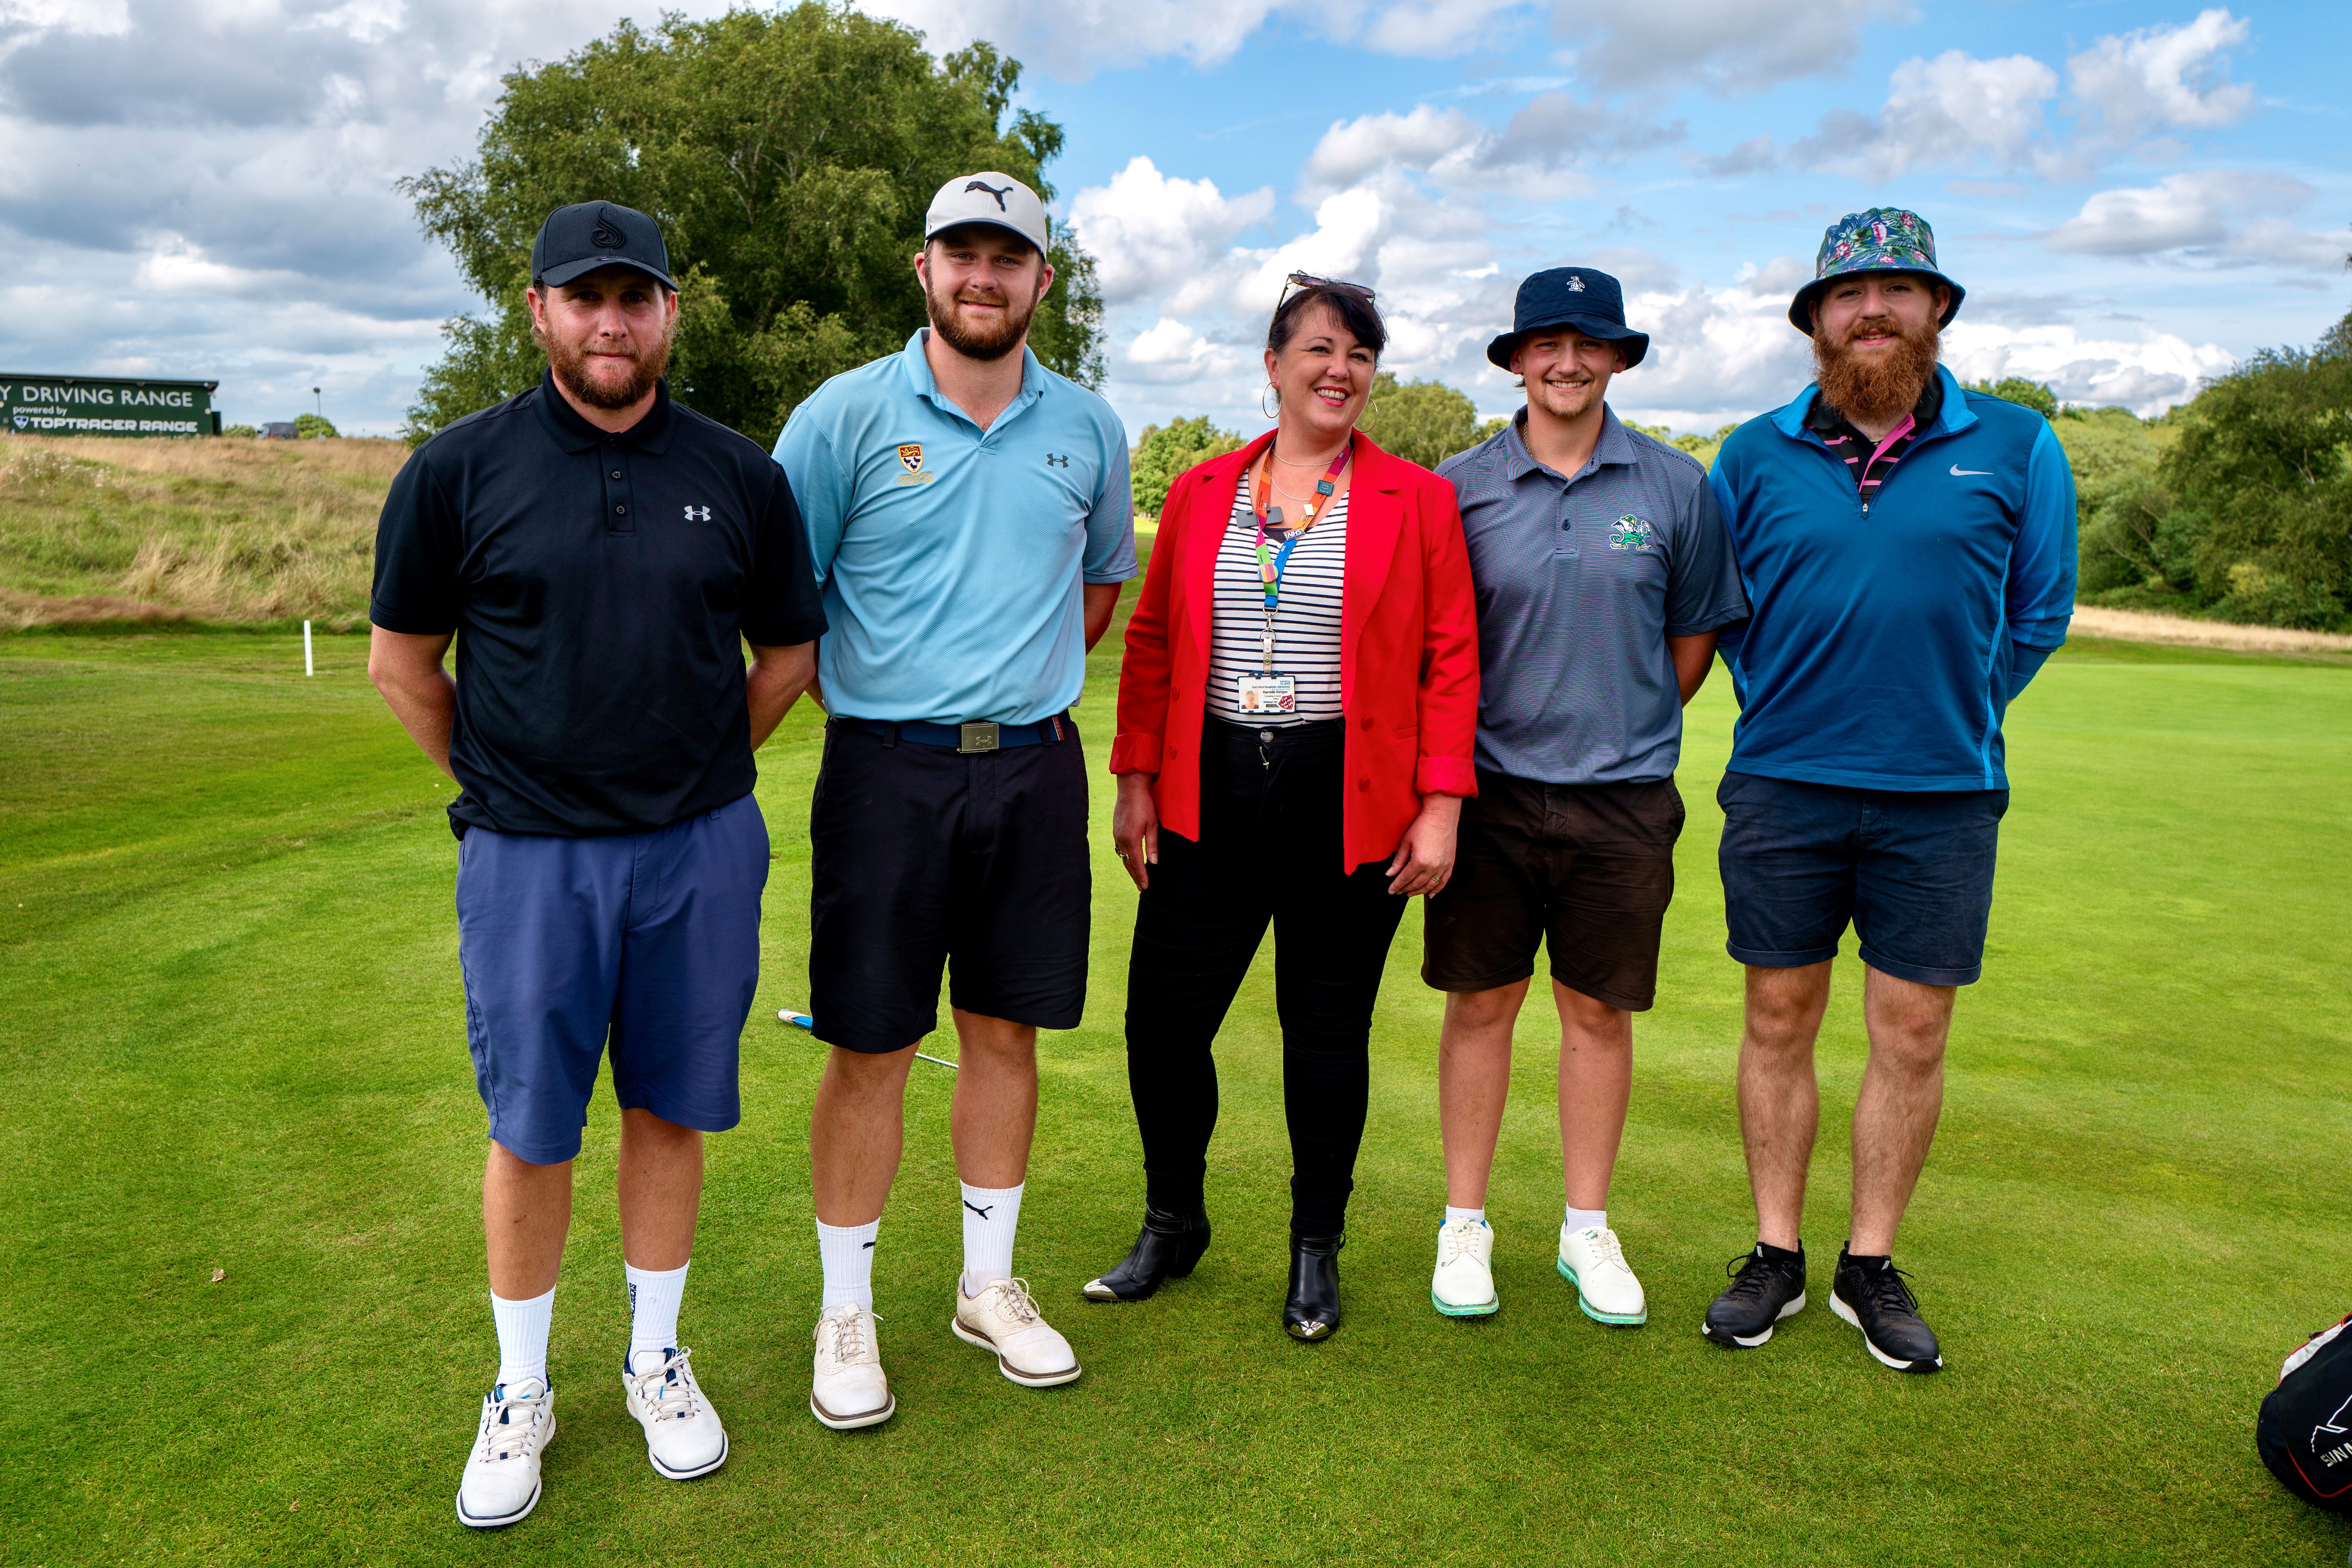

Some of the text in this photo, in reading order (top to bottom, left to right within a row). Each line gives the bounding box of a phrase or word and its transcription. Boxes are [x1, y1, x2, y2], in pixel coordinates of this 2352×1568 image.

[23, 386, 114, 404] DRIVING
[121, 389, 193, 407] RANGE
[13, 405, 67, 417] powered by
[30, 417, 198, 432] TOPTRACER RANGE
[897, 472, 932, 481] CANTERBURY
[1287, 529, 1302, 538] NHS
